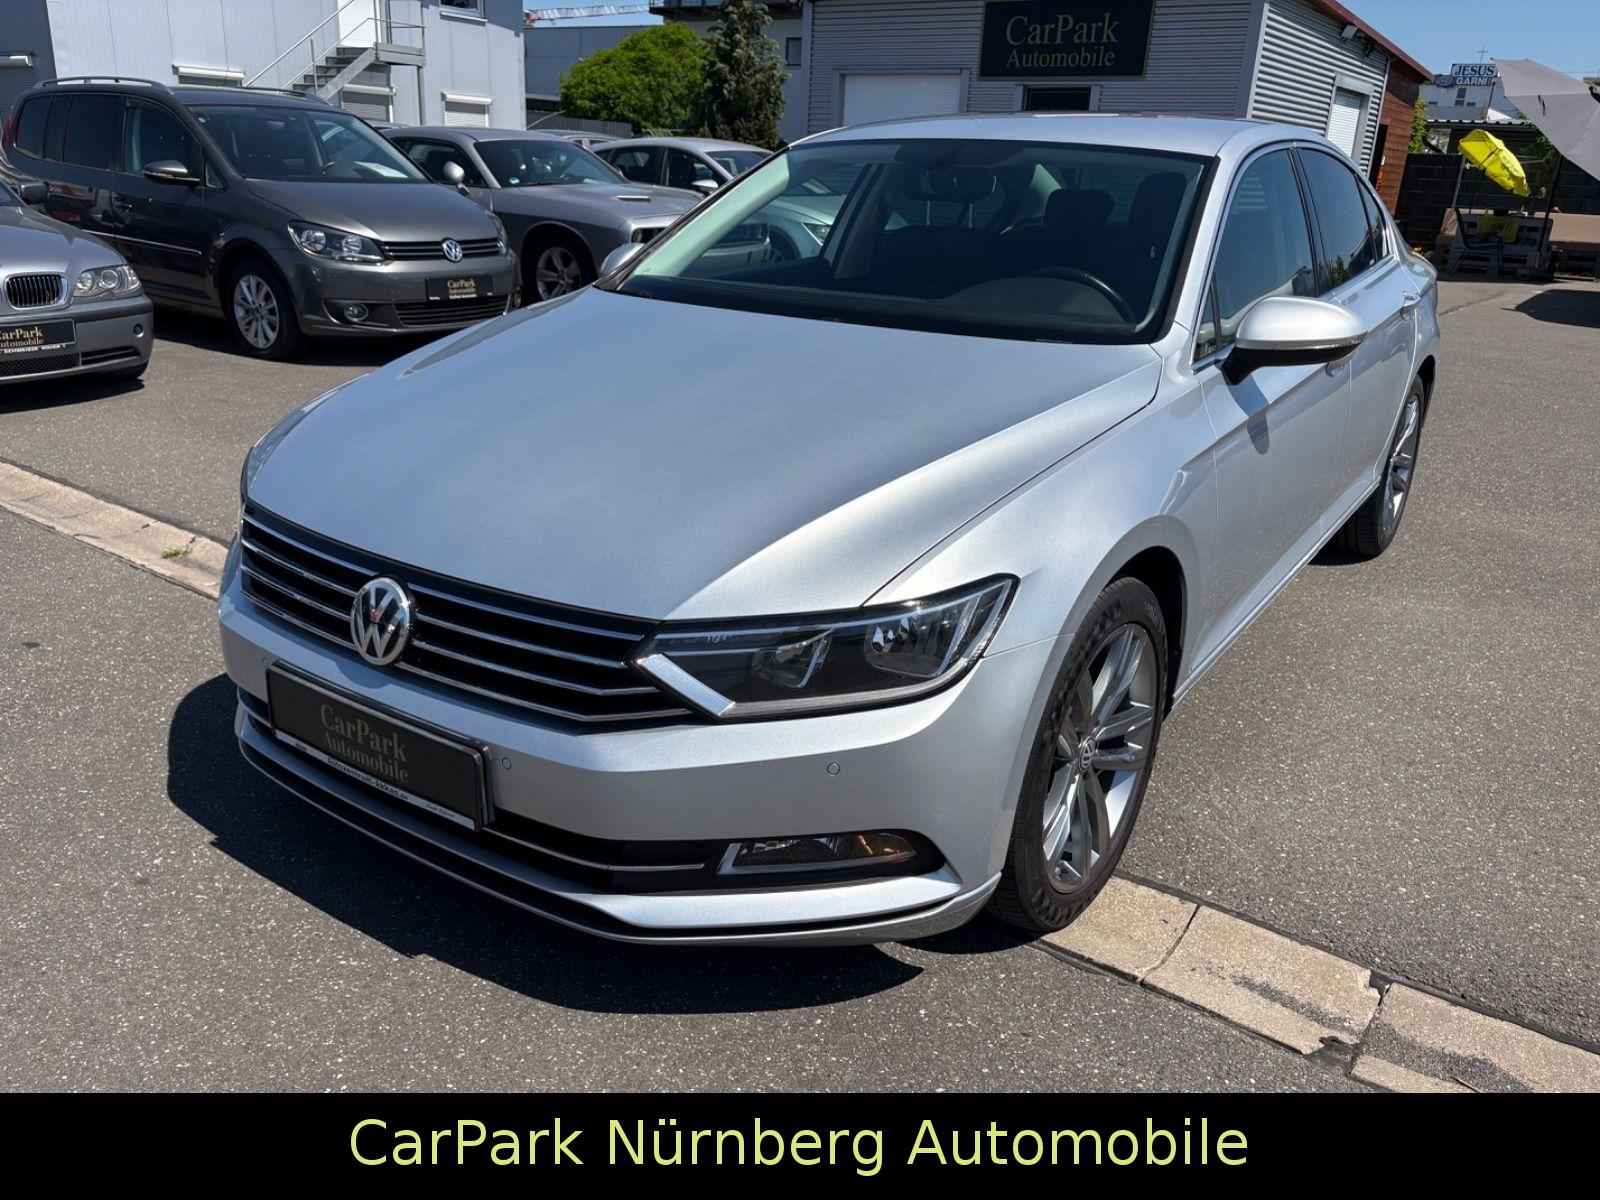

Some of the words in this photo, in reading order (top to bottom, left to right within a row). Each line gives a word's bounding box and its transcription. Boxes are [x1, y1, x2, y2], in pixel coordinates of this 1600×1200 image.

[1005, 12, 1120, 45] CarPark
[1006, 46, 1116, 68] Automobile
[1454, 65, 1495, 76] JESUS
[0, 336, 45, 348] utomobile
[320, 703, 408, 764] CarPark
[322, 730, 409, 784] Automobile
